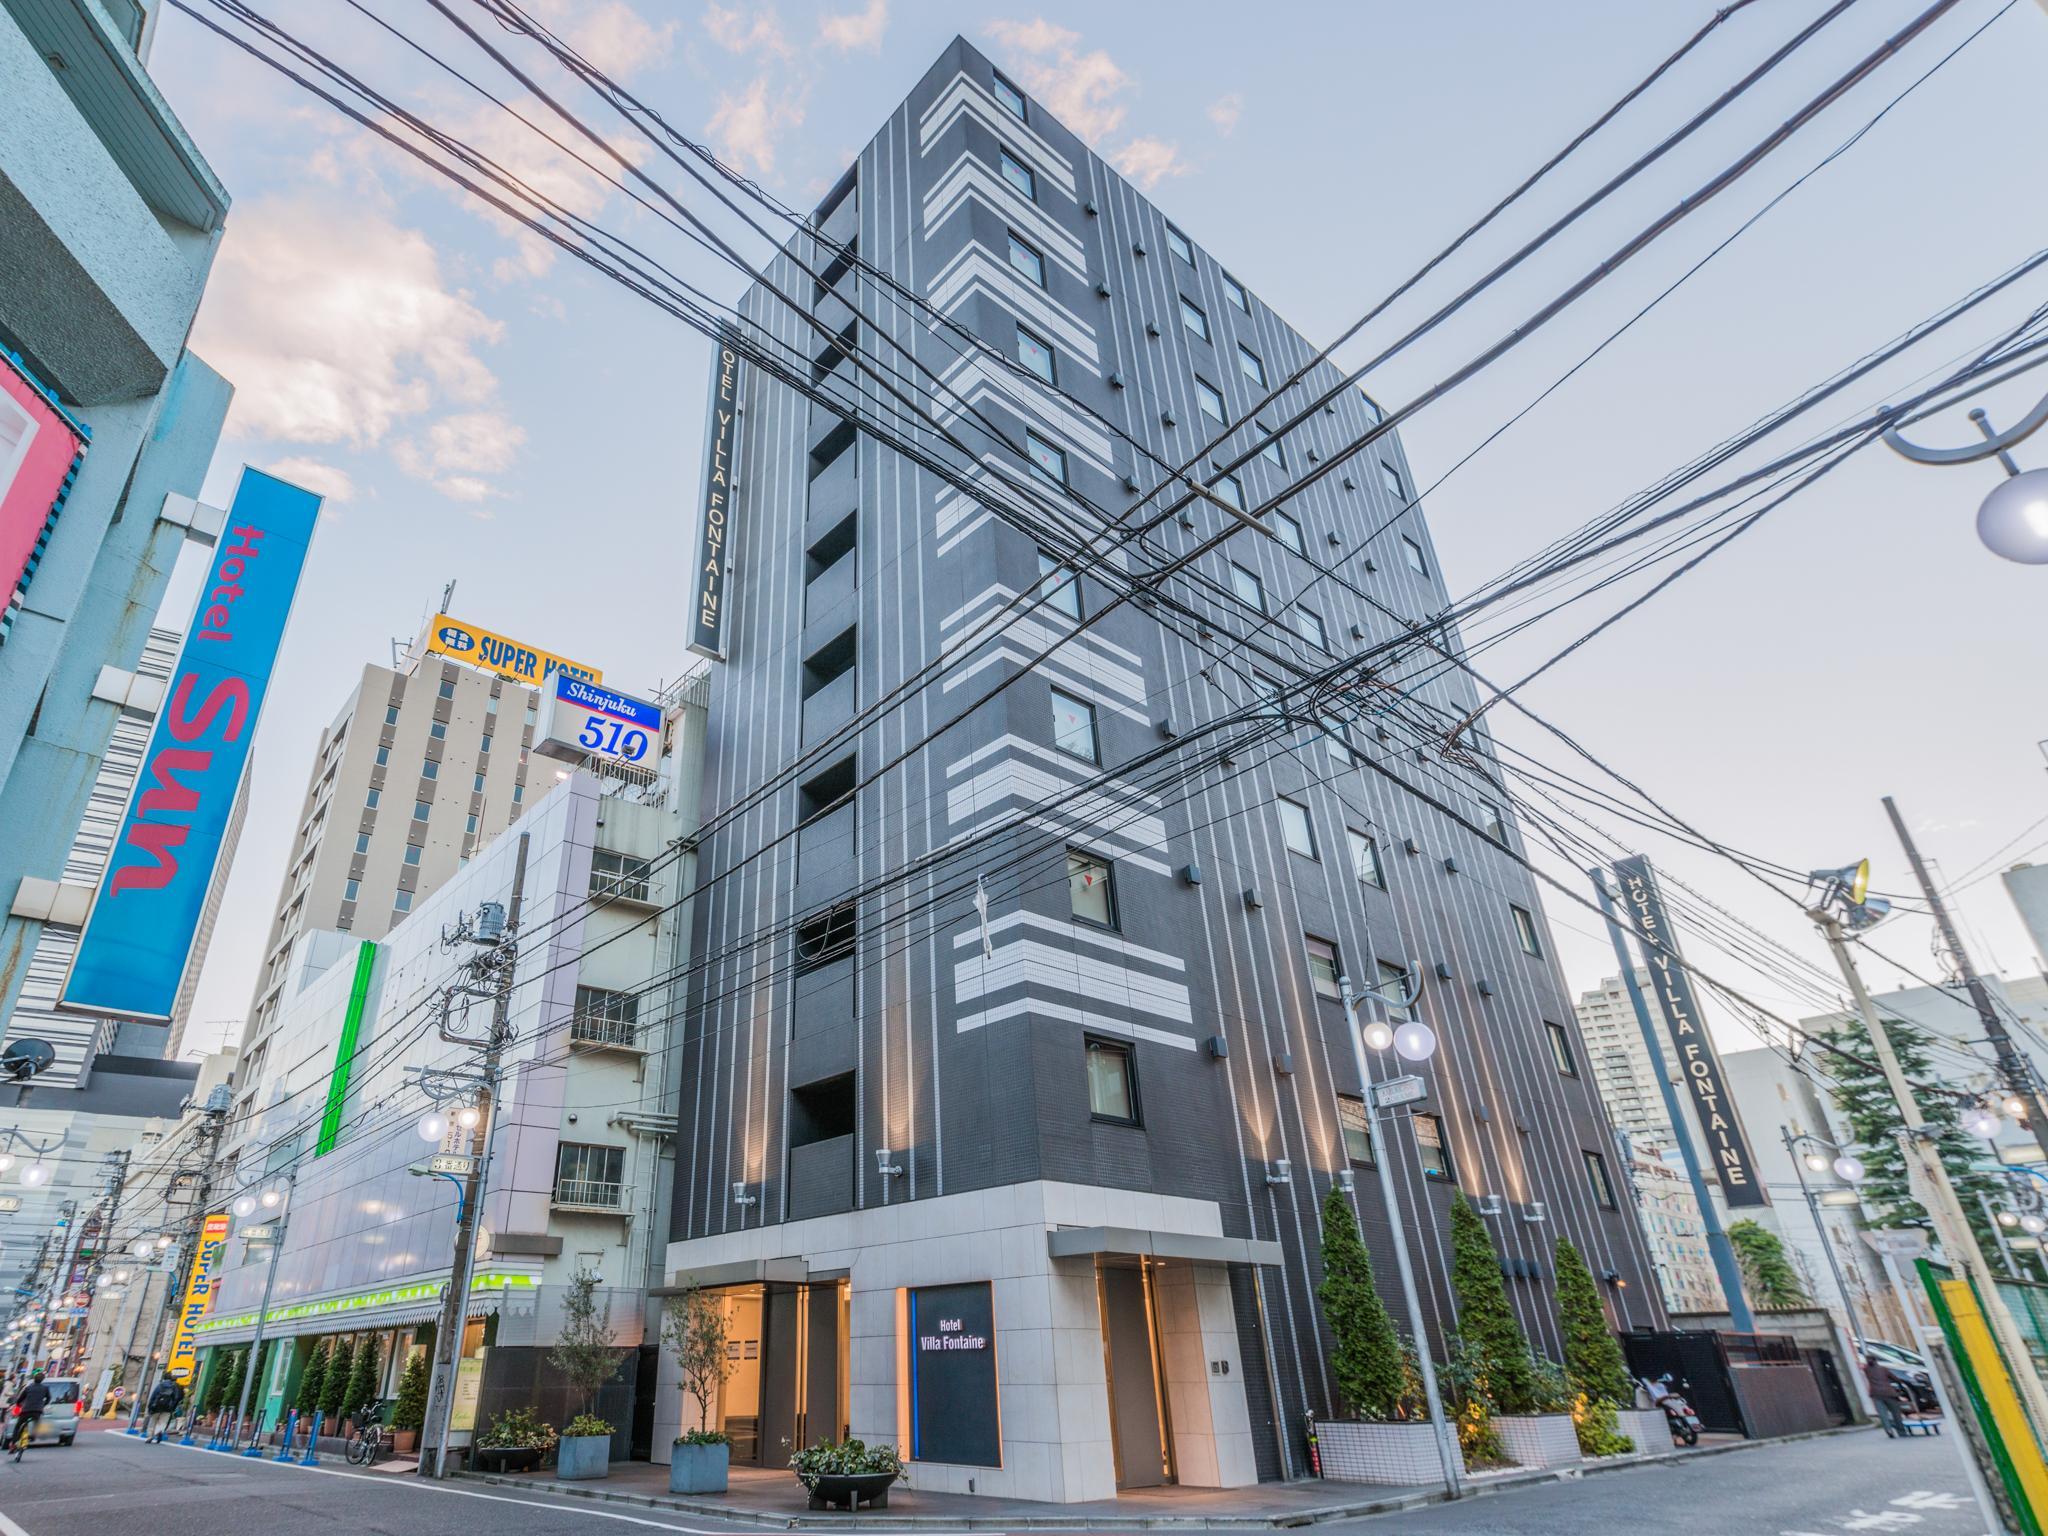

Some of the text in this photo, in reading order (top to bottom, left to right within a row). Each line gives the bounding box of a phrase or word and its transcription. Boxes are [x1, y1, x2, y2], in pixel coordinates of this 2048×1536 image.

[701, 339, 735, 629] OTEL VILLA FONTAINE
[478, 636, 537, 679] SUPER
[110, 523, 266, 899] Hotel Sun
[566, 682, 637, 717] Shinjuku
[578, 716, 648, 762] 510
[1653, 955, 1695, 1036] VILLA
[1685, 1044, 1747, 1186] FONTAINE
[921, 1335, 985, 1351] Villa Fontaine
[940, 1318, 961, 1332] Hotel
